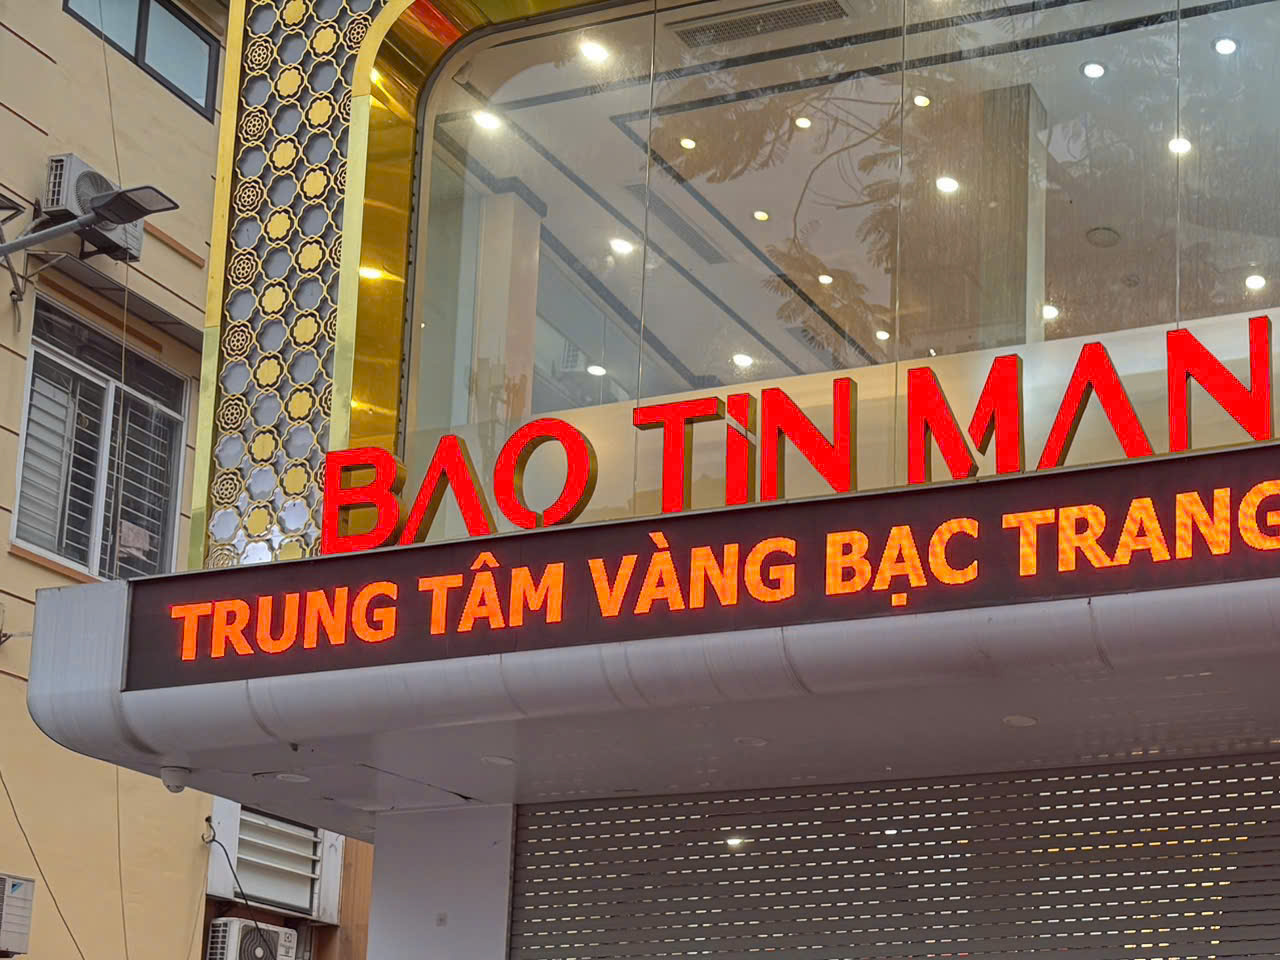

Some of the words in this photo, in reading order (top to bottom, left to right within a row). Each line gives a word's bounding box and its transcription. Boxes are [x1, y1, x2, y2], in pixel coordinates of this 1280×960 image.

[172, 582, 397, 661] TRUNG
[418, 552, 564, 635] TÂM
[589, 532, 796, 617] VÀNG
[825, 520, 979, 606] BẠC
